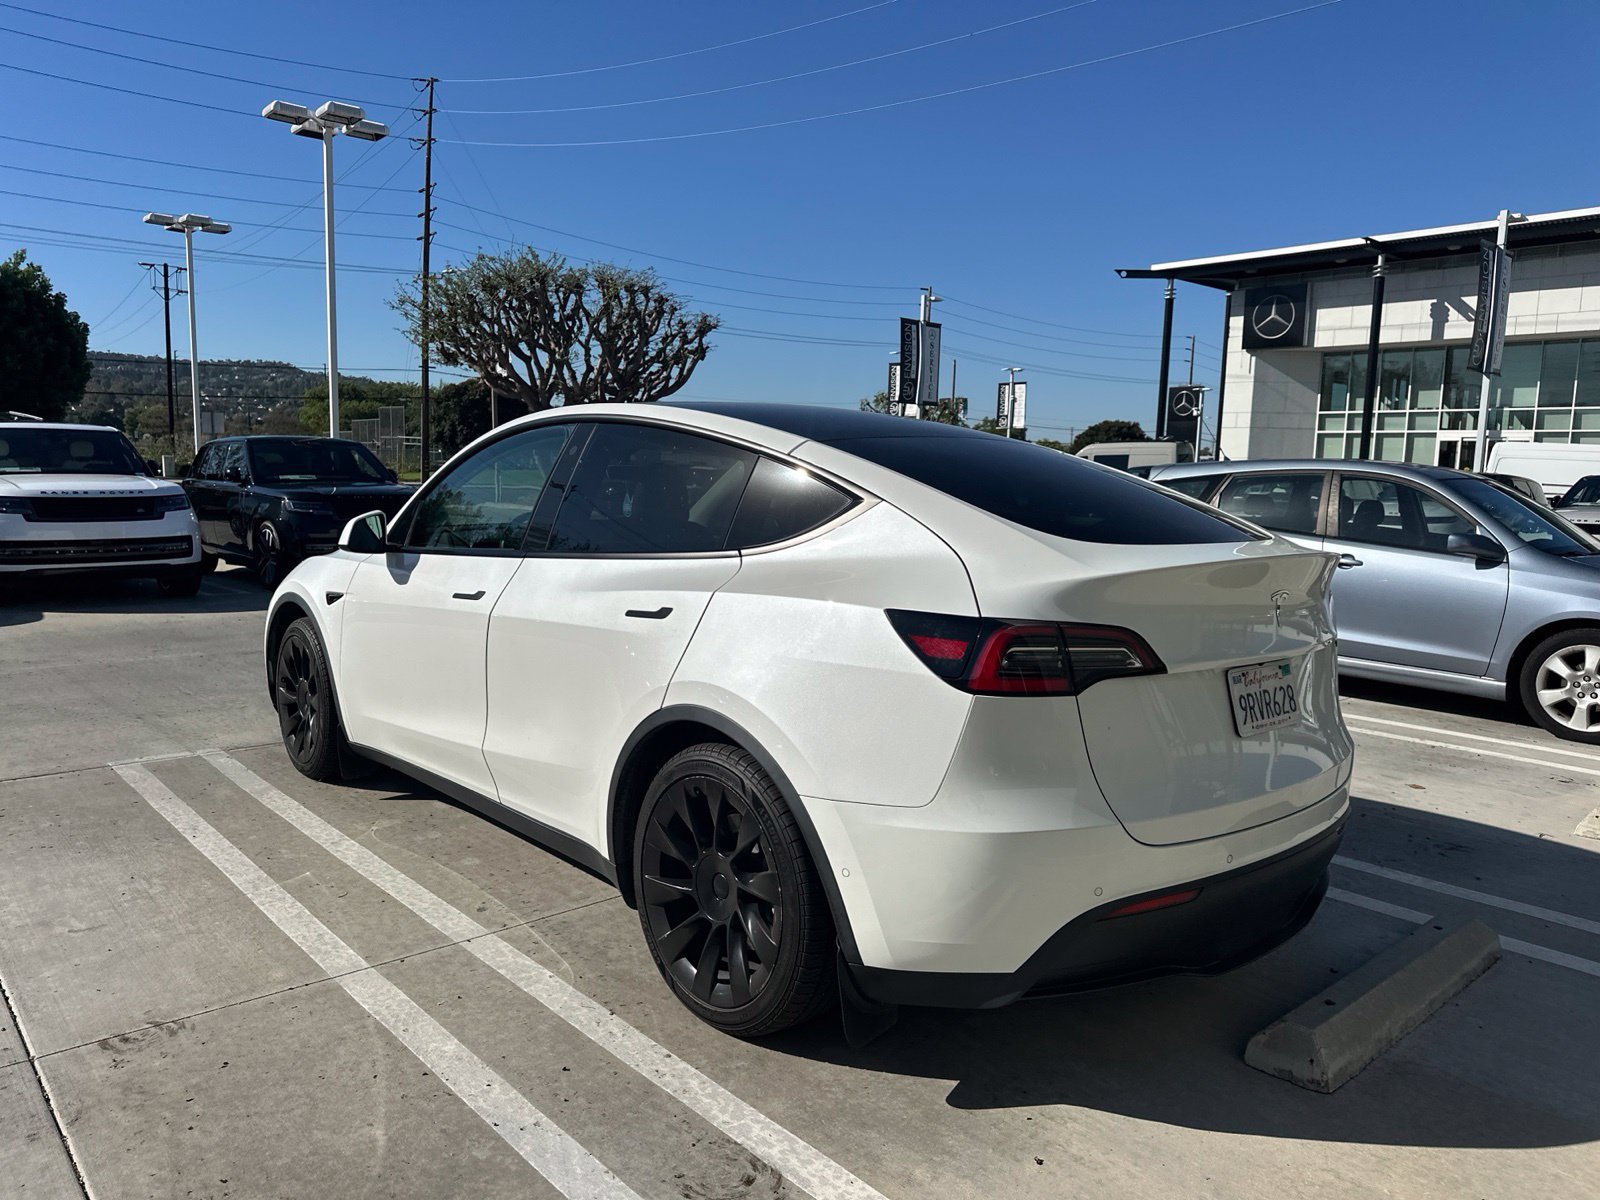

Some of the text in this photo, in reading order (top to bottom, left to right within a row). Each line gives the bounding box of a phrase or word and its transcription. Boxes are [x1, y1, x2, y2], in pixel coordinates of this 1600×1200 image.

[1478, 247, 1489, 333] ENVISION
[904, 323, 912, 379] ENVISION
[1243, 671, 1283, 688] California
[1239, 684, 1297, 725] 9RVR628
